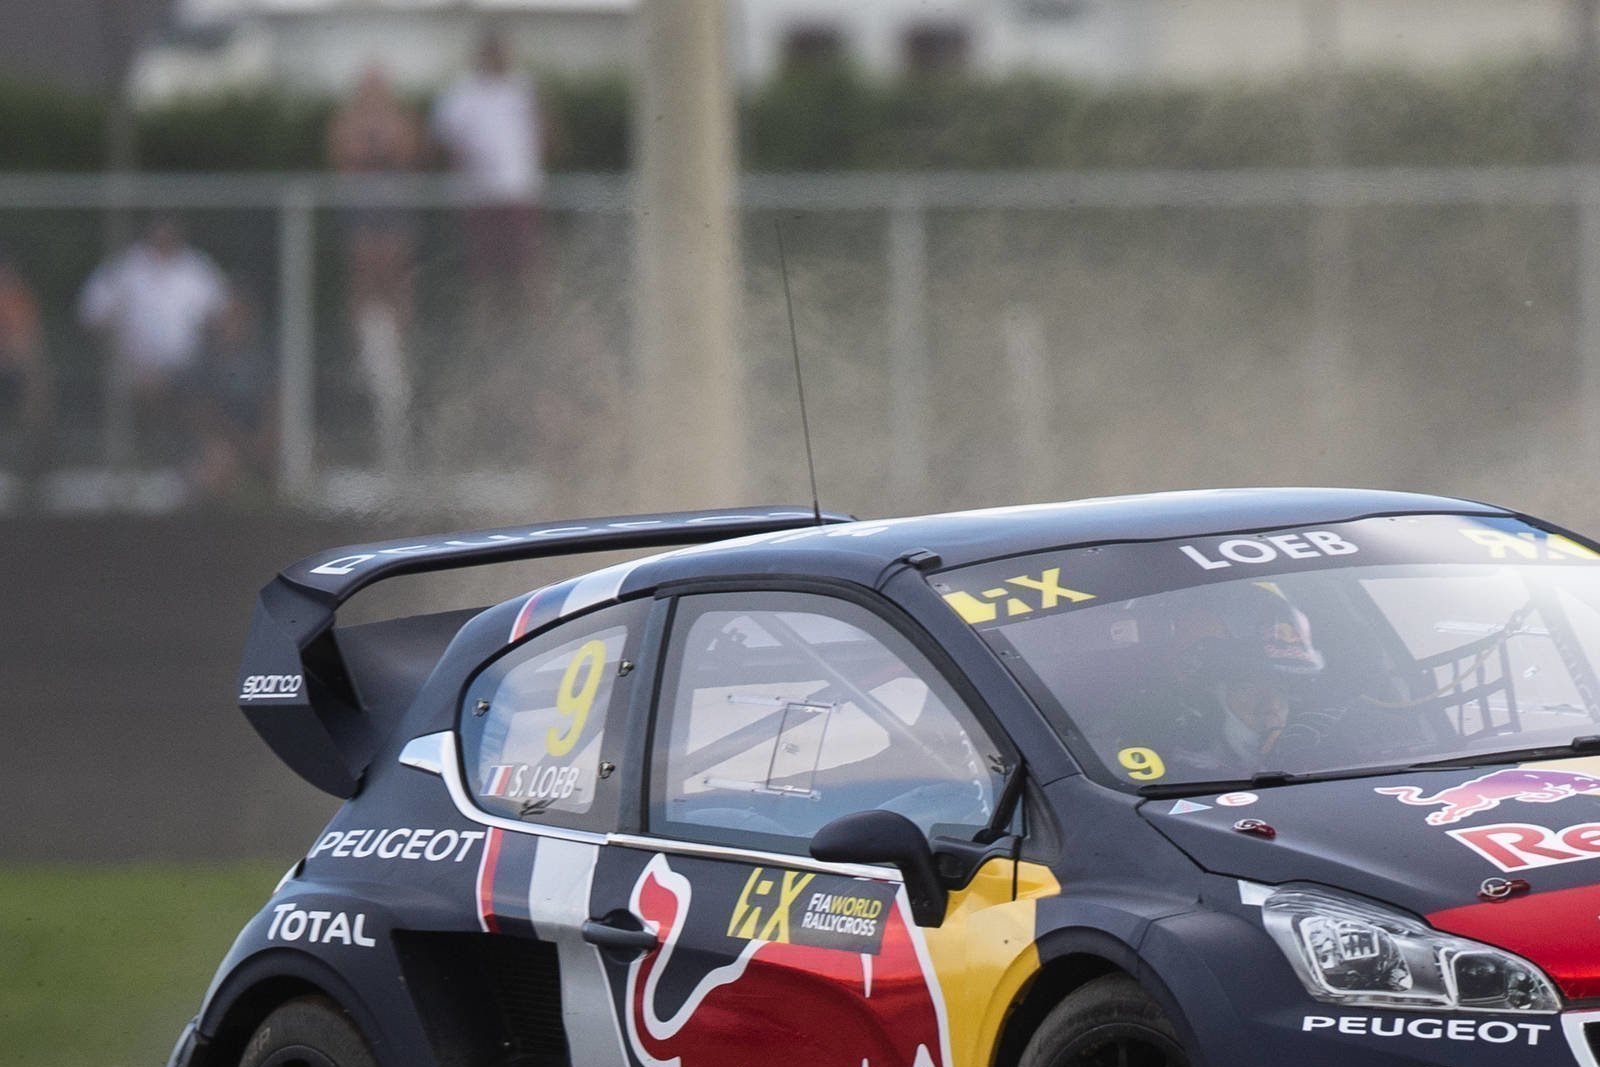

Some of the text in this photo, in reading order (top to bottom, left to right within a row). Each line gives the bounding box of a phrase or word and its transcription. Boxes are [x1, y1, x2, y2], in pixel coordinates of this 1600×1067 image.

[1179, 530, 1360, 571] LOEB
[240, 674, 303, 701] sparco
[545, 639, 607, 757] 9
[1117, 746, 1166, 781] 9
[508, 765, 582, 798] S. LOEB
[310, 828, 486, 863] PEUGEOT
[267, 902, 377, 948] TOTAL
[802, 912, 877, 937] RALLYCROSS
[1302, 1015, 1552, 1046] PEUGEOT
